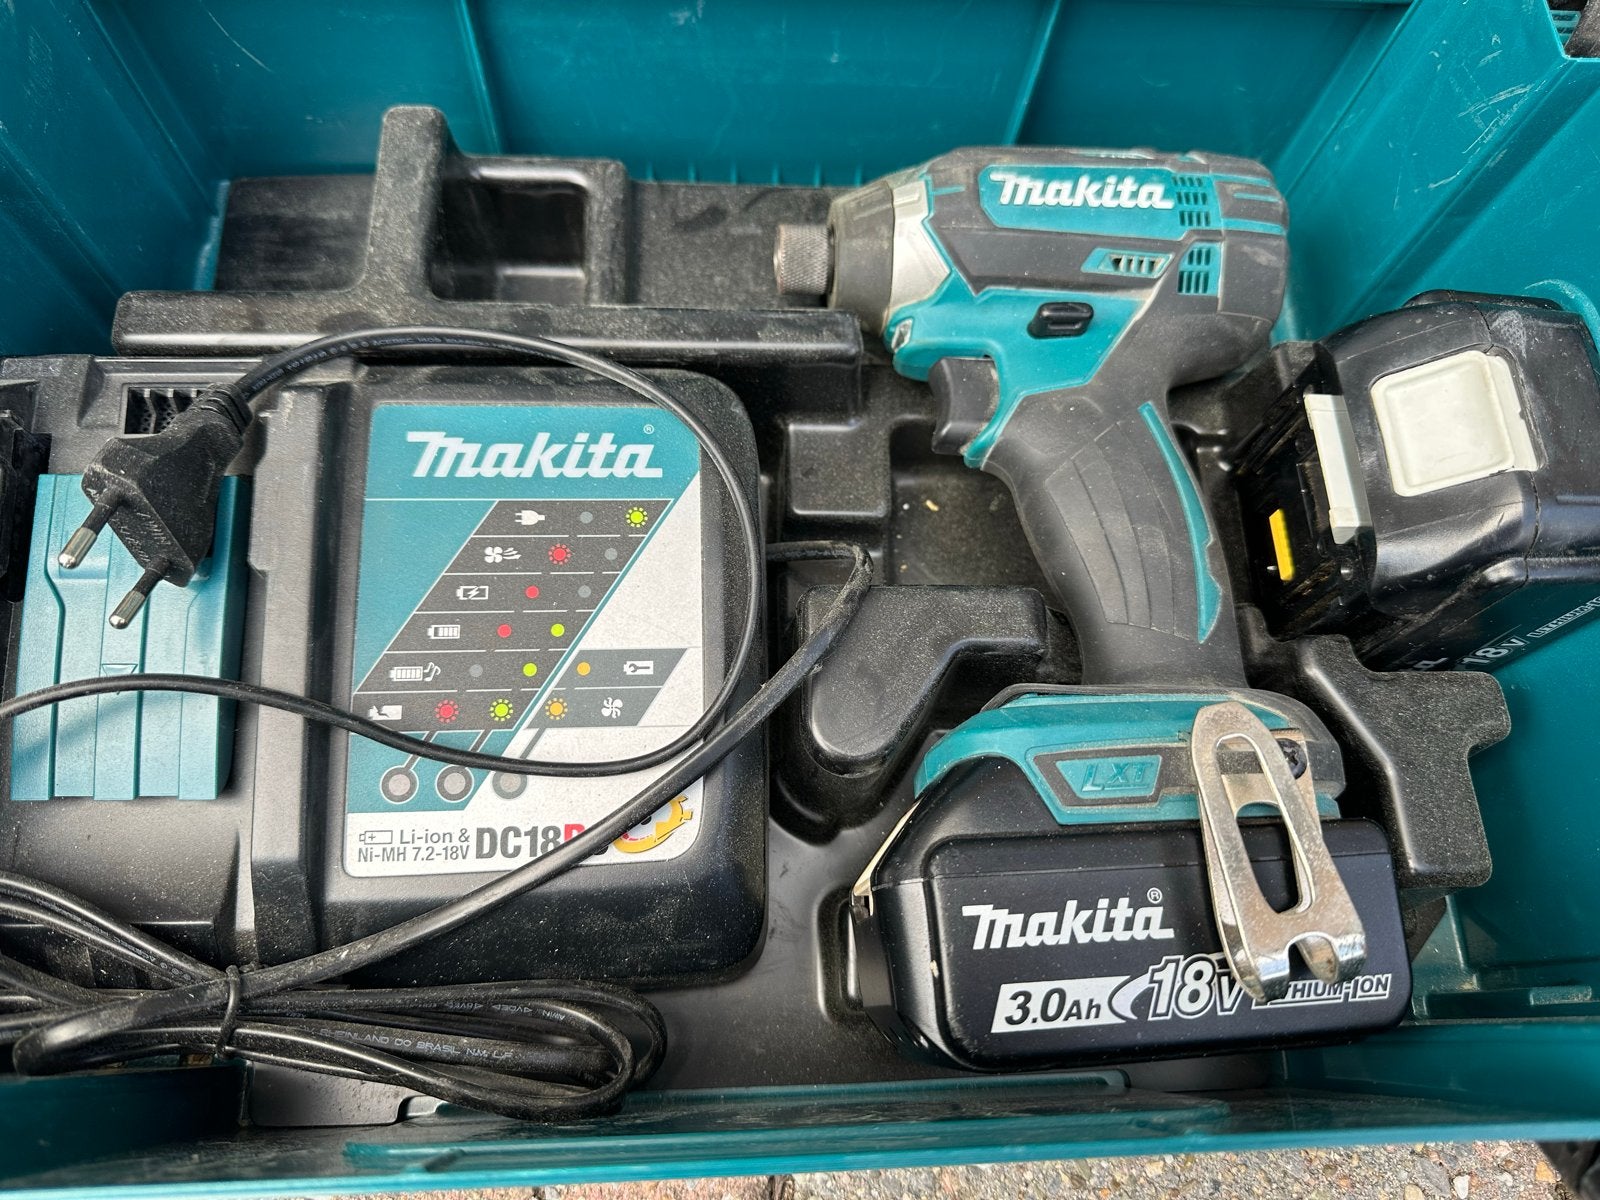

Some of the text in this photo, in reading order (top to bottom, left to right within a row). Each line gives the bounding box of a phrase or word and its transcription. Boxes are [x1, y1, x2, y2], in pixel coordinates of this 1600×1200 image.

[1463, 634, 1525, 665] 18V
[1081, 762, 1154, 792] LXT
[357, 823, 604, 863] Ni-MH 7.2-18V DC18
[399, 830, 471, 845] Li-ion &
[1004, 987, 1101, 1026] 3.0Ah
